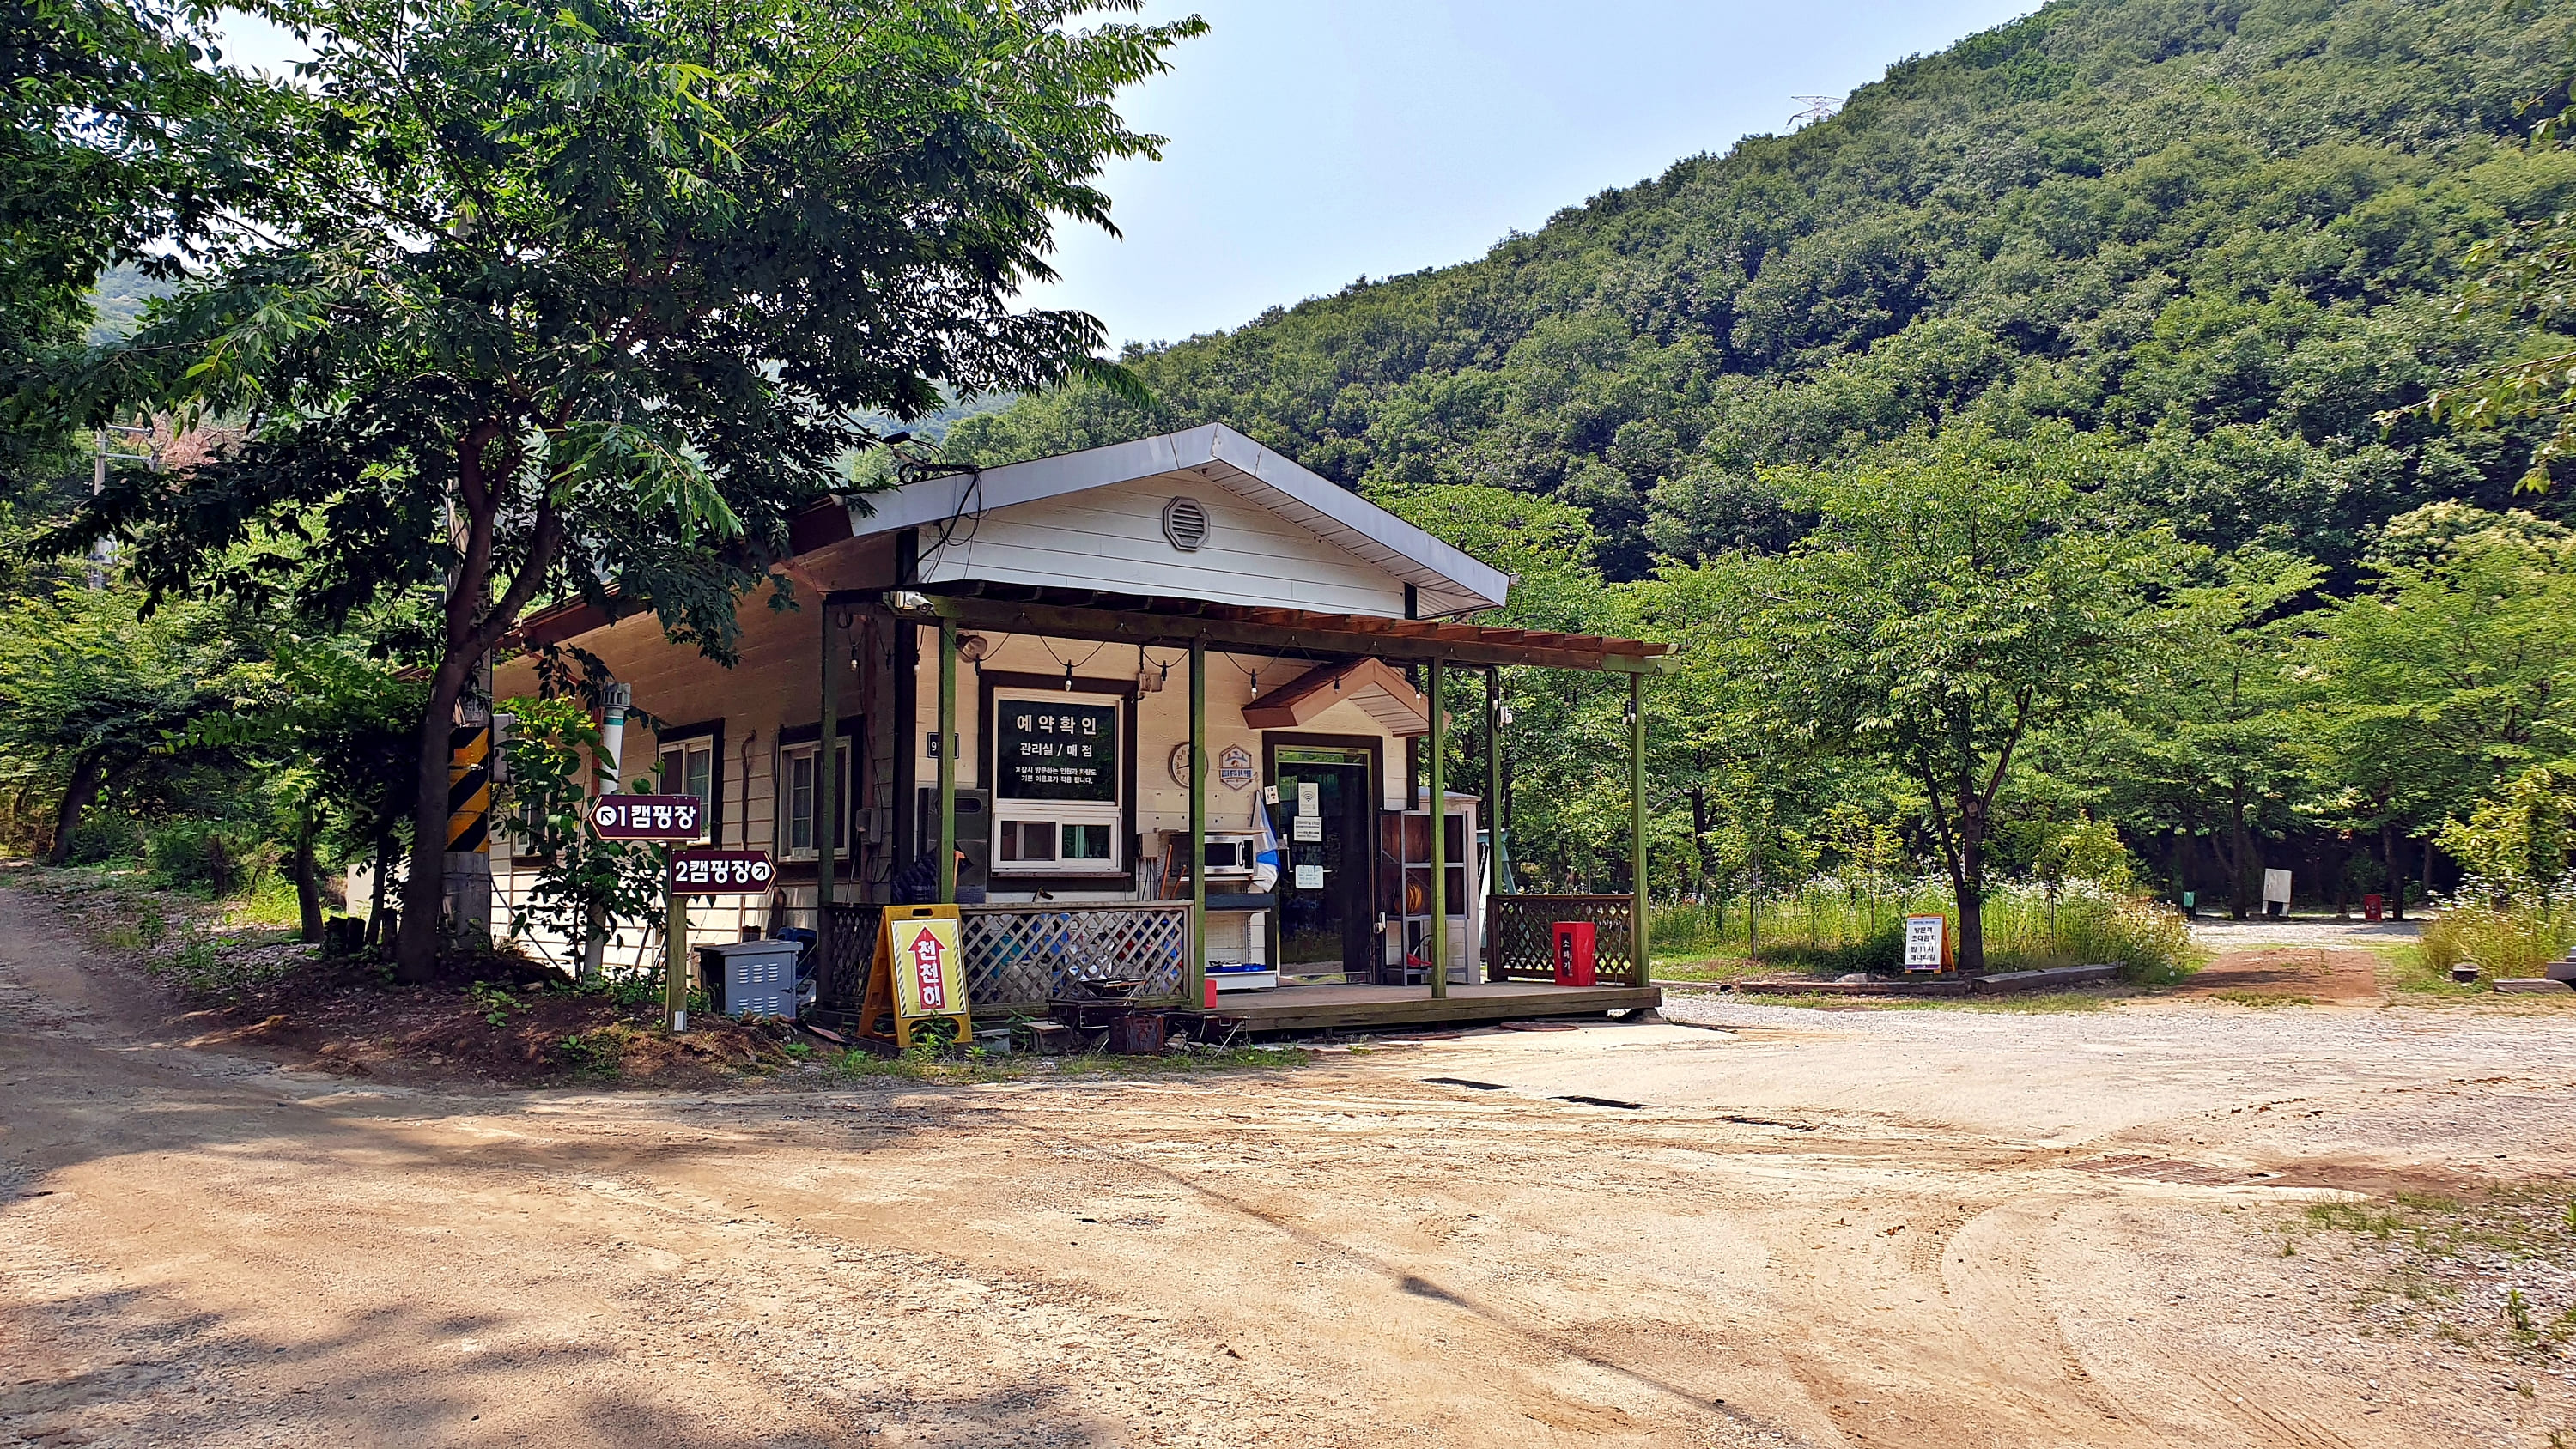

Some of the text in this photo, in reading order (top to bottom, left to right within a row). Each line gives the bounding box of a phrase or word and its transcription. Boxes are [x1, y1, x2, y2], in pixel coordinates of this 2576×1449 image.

[1019, 743, 1054, 756] 관리실
[617, 804, 696, 830] 1캠핑장
[675, 859, 751, 884] 2캠핑장
[917, 940, 941, 1006] 천천히
